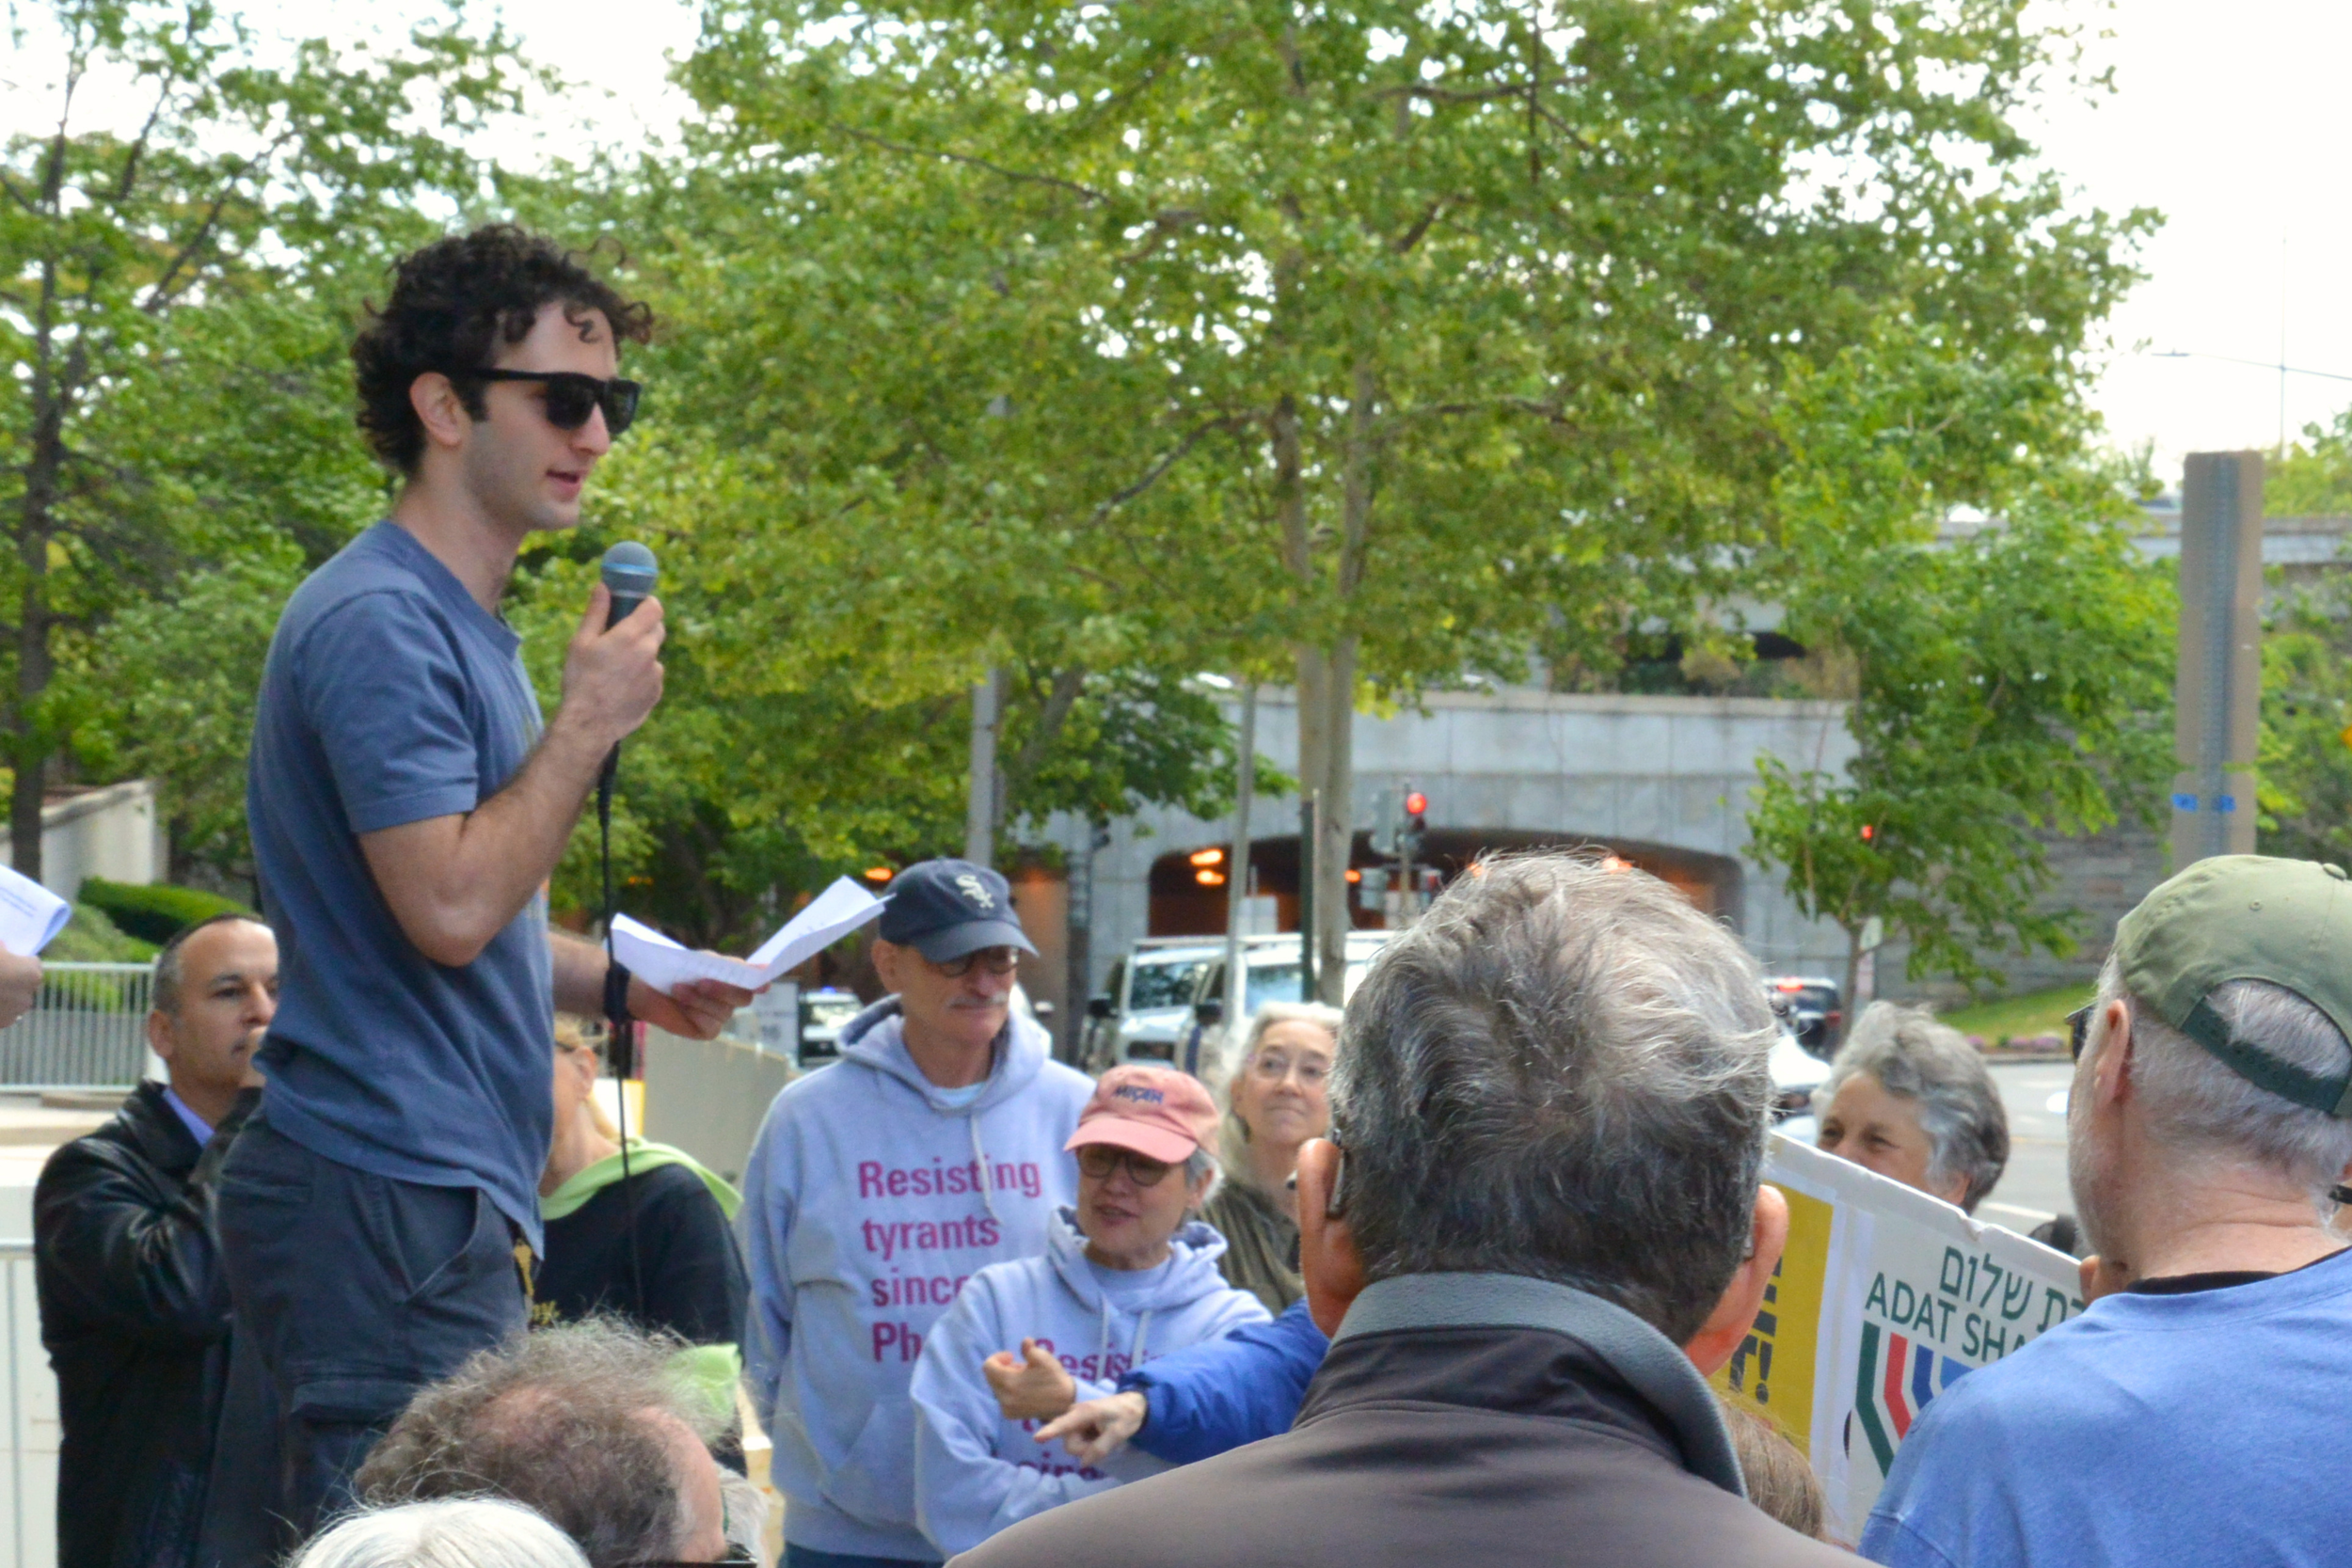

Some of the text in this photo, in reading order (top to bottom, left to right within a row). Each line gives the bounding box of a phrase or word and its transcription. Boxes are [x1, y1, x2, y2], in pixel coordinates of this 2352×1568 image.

[858, 1154, 1041, 1198] Resisting
[863, 1214, 1001, 1261] tyrants
[1939, 1245, 2033, 1321] שלום
[1865, 1271, 1957, 1343] ADAT
[872, 1322, 922, 1362] Ph
